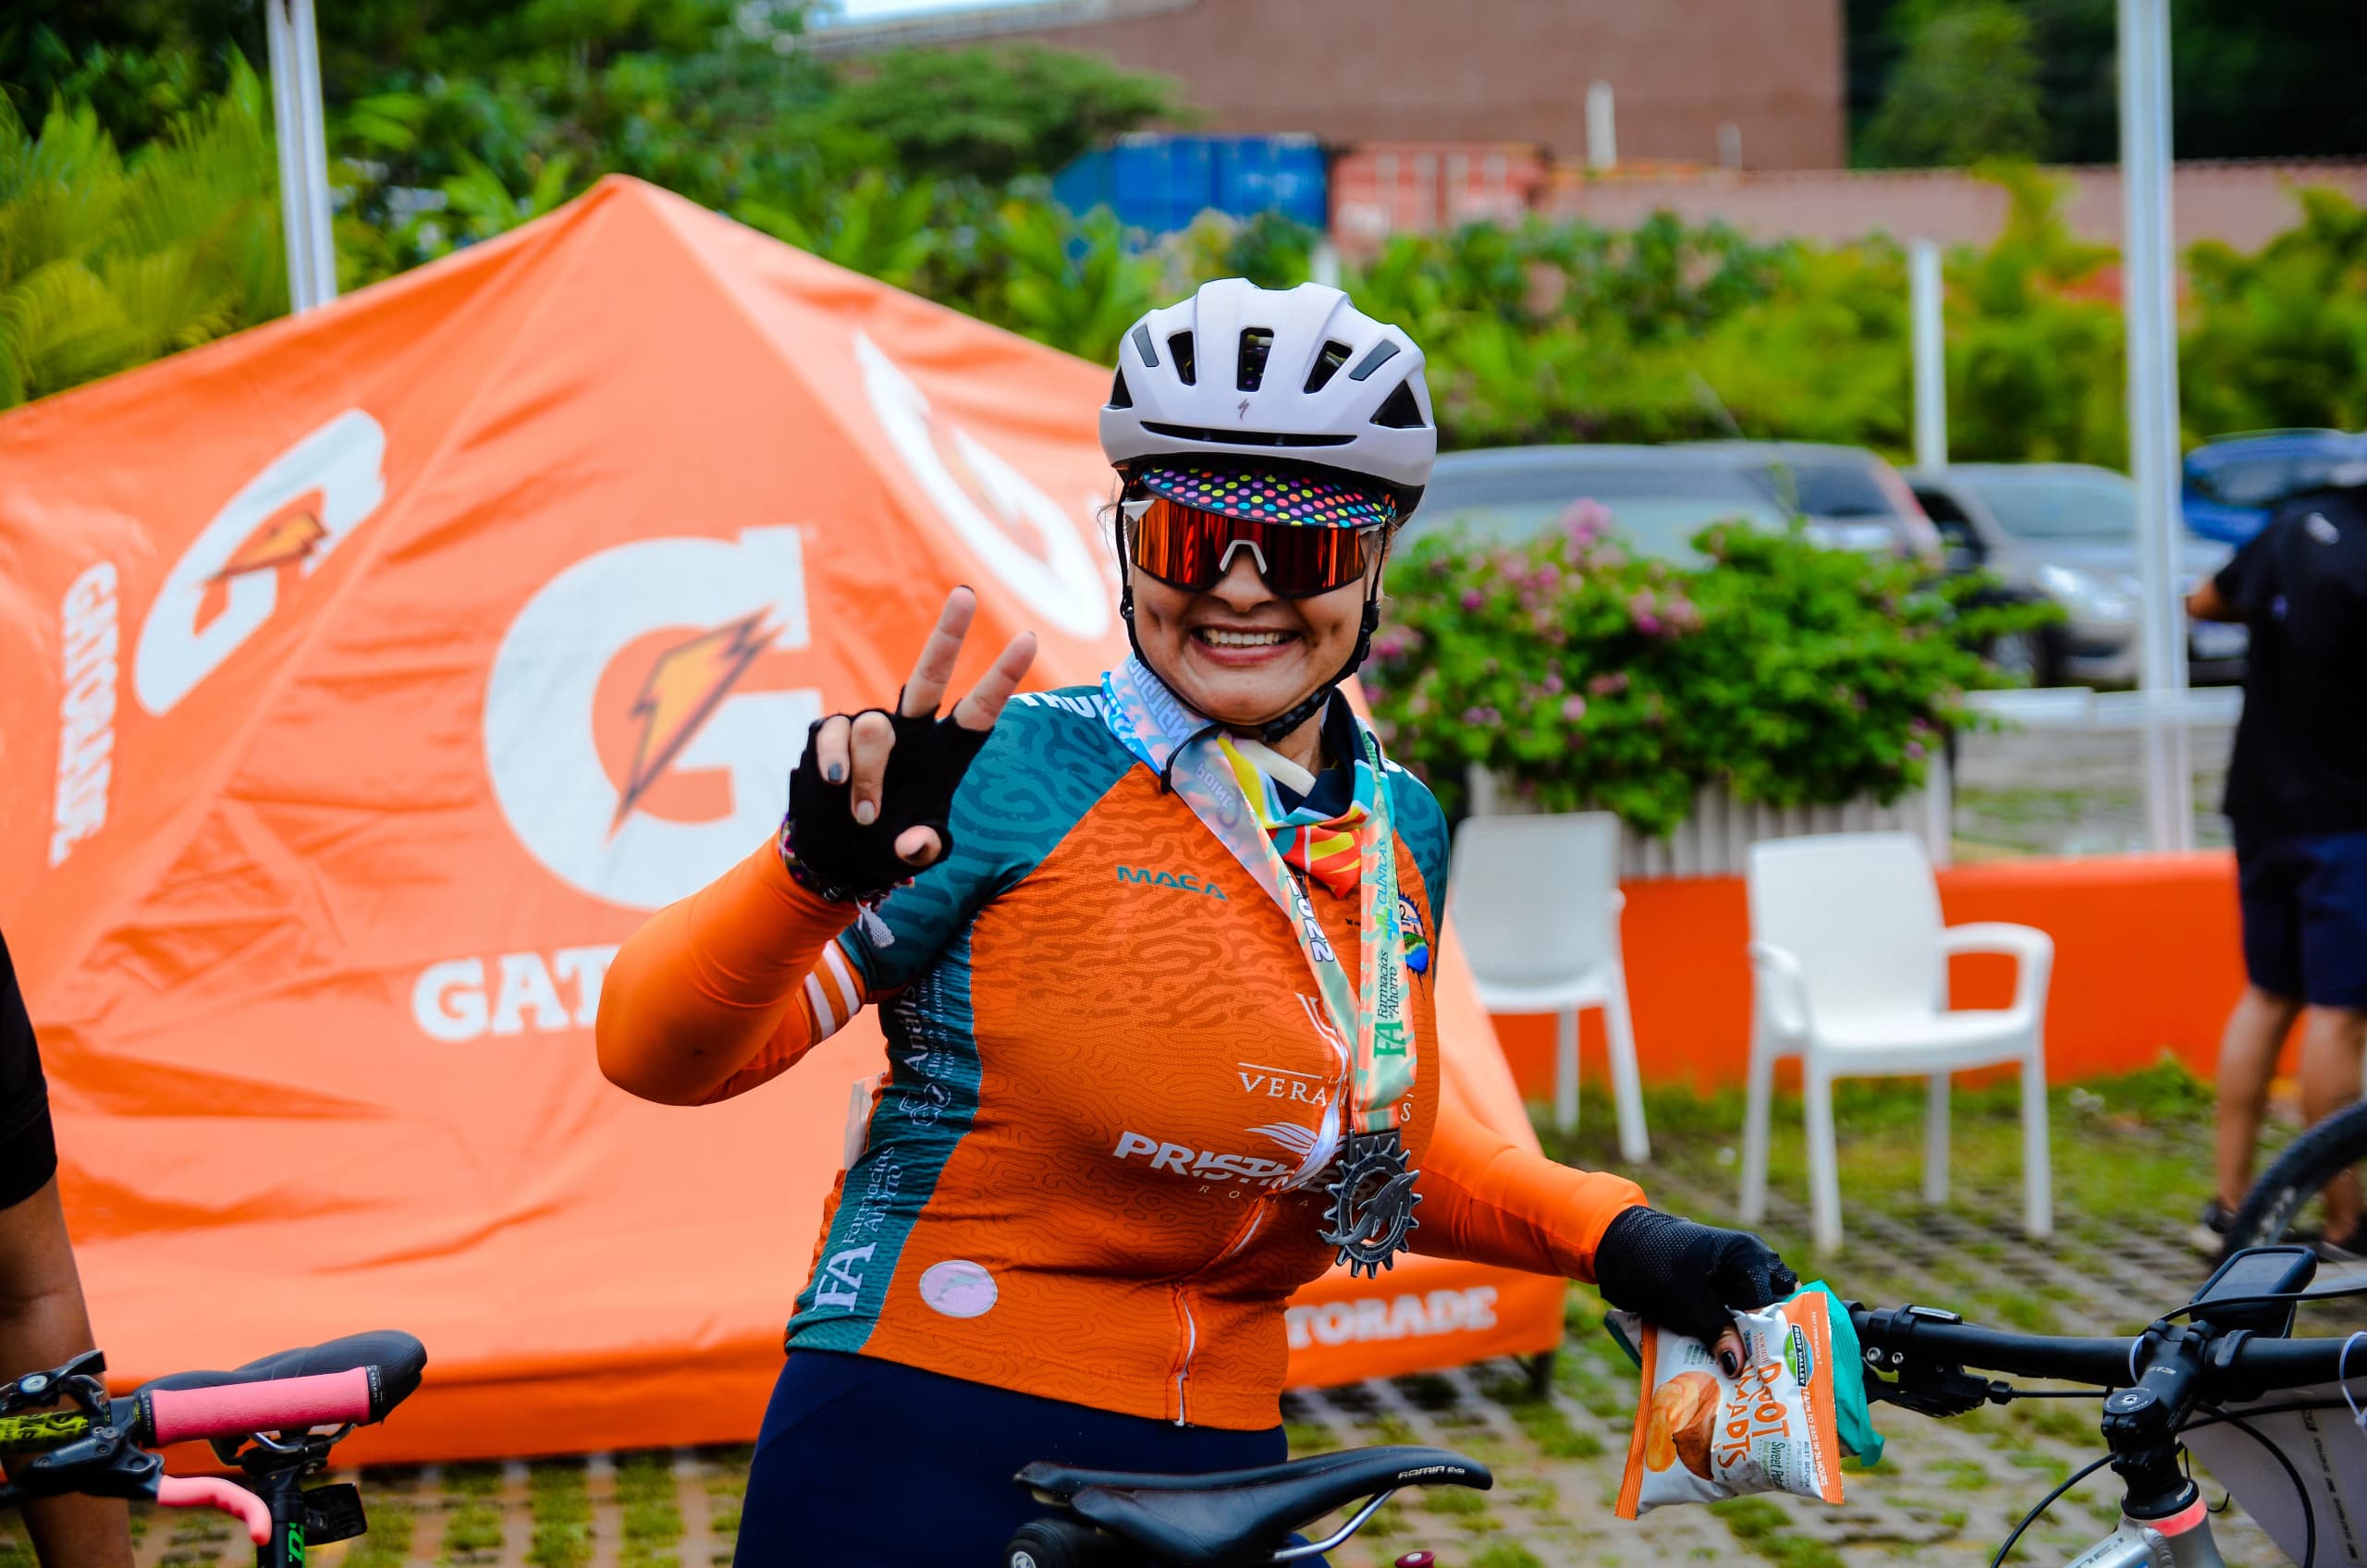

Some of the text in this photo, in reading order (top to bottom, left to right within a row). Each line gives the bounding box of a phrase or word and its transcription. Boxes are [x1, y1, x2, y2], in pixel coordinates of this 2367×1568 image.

[483, 524, 823, 911] G
[1116, 864, 1229, 901] MACA
[411, 942, 623, 1043] GAT
[1378, 949, 1390, 1020] Farmacias
[1389, 966, 1400, 1015] Ahorro
[1373, 1020, 1407, 1059] FA
[840, 1145, 895, 1244] Farmacias
[863, 1164, 903, 1233] Ahorro
[811, 1241, 877, 1313] FA
[1283, 1285, 1499, 1350] TORADE
[1793, 1326, 1806, 1385] ROOT VALLEY
[1770, 1441, 1785, 1468] Sweet
